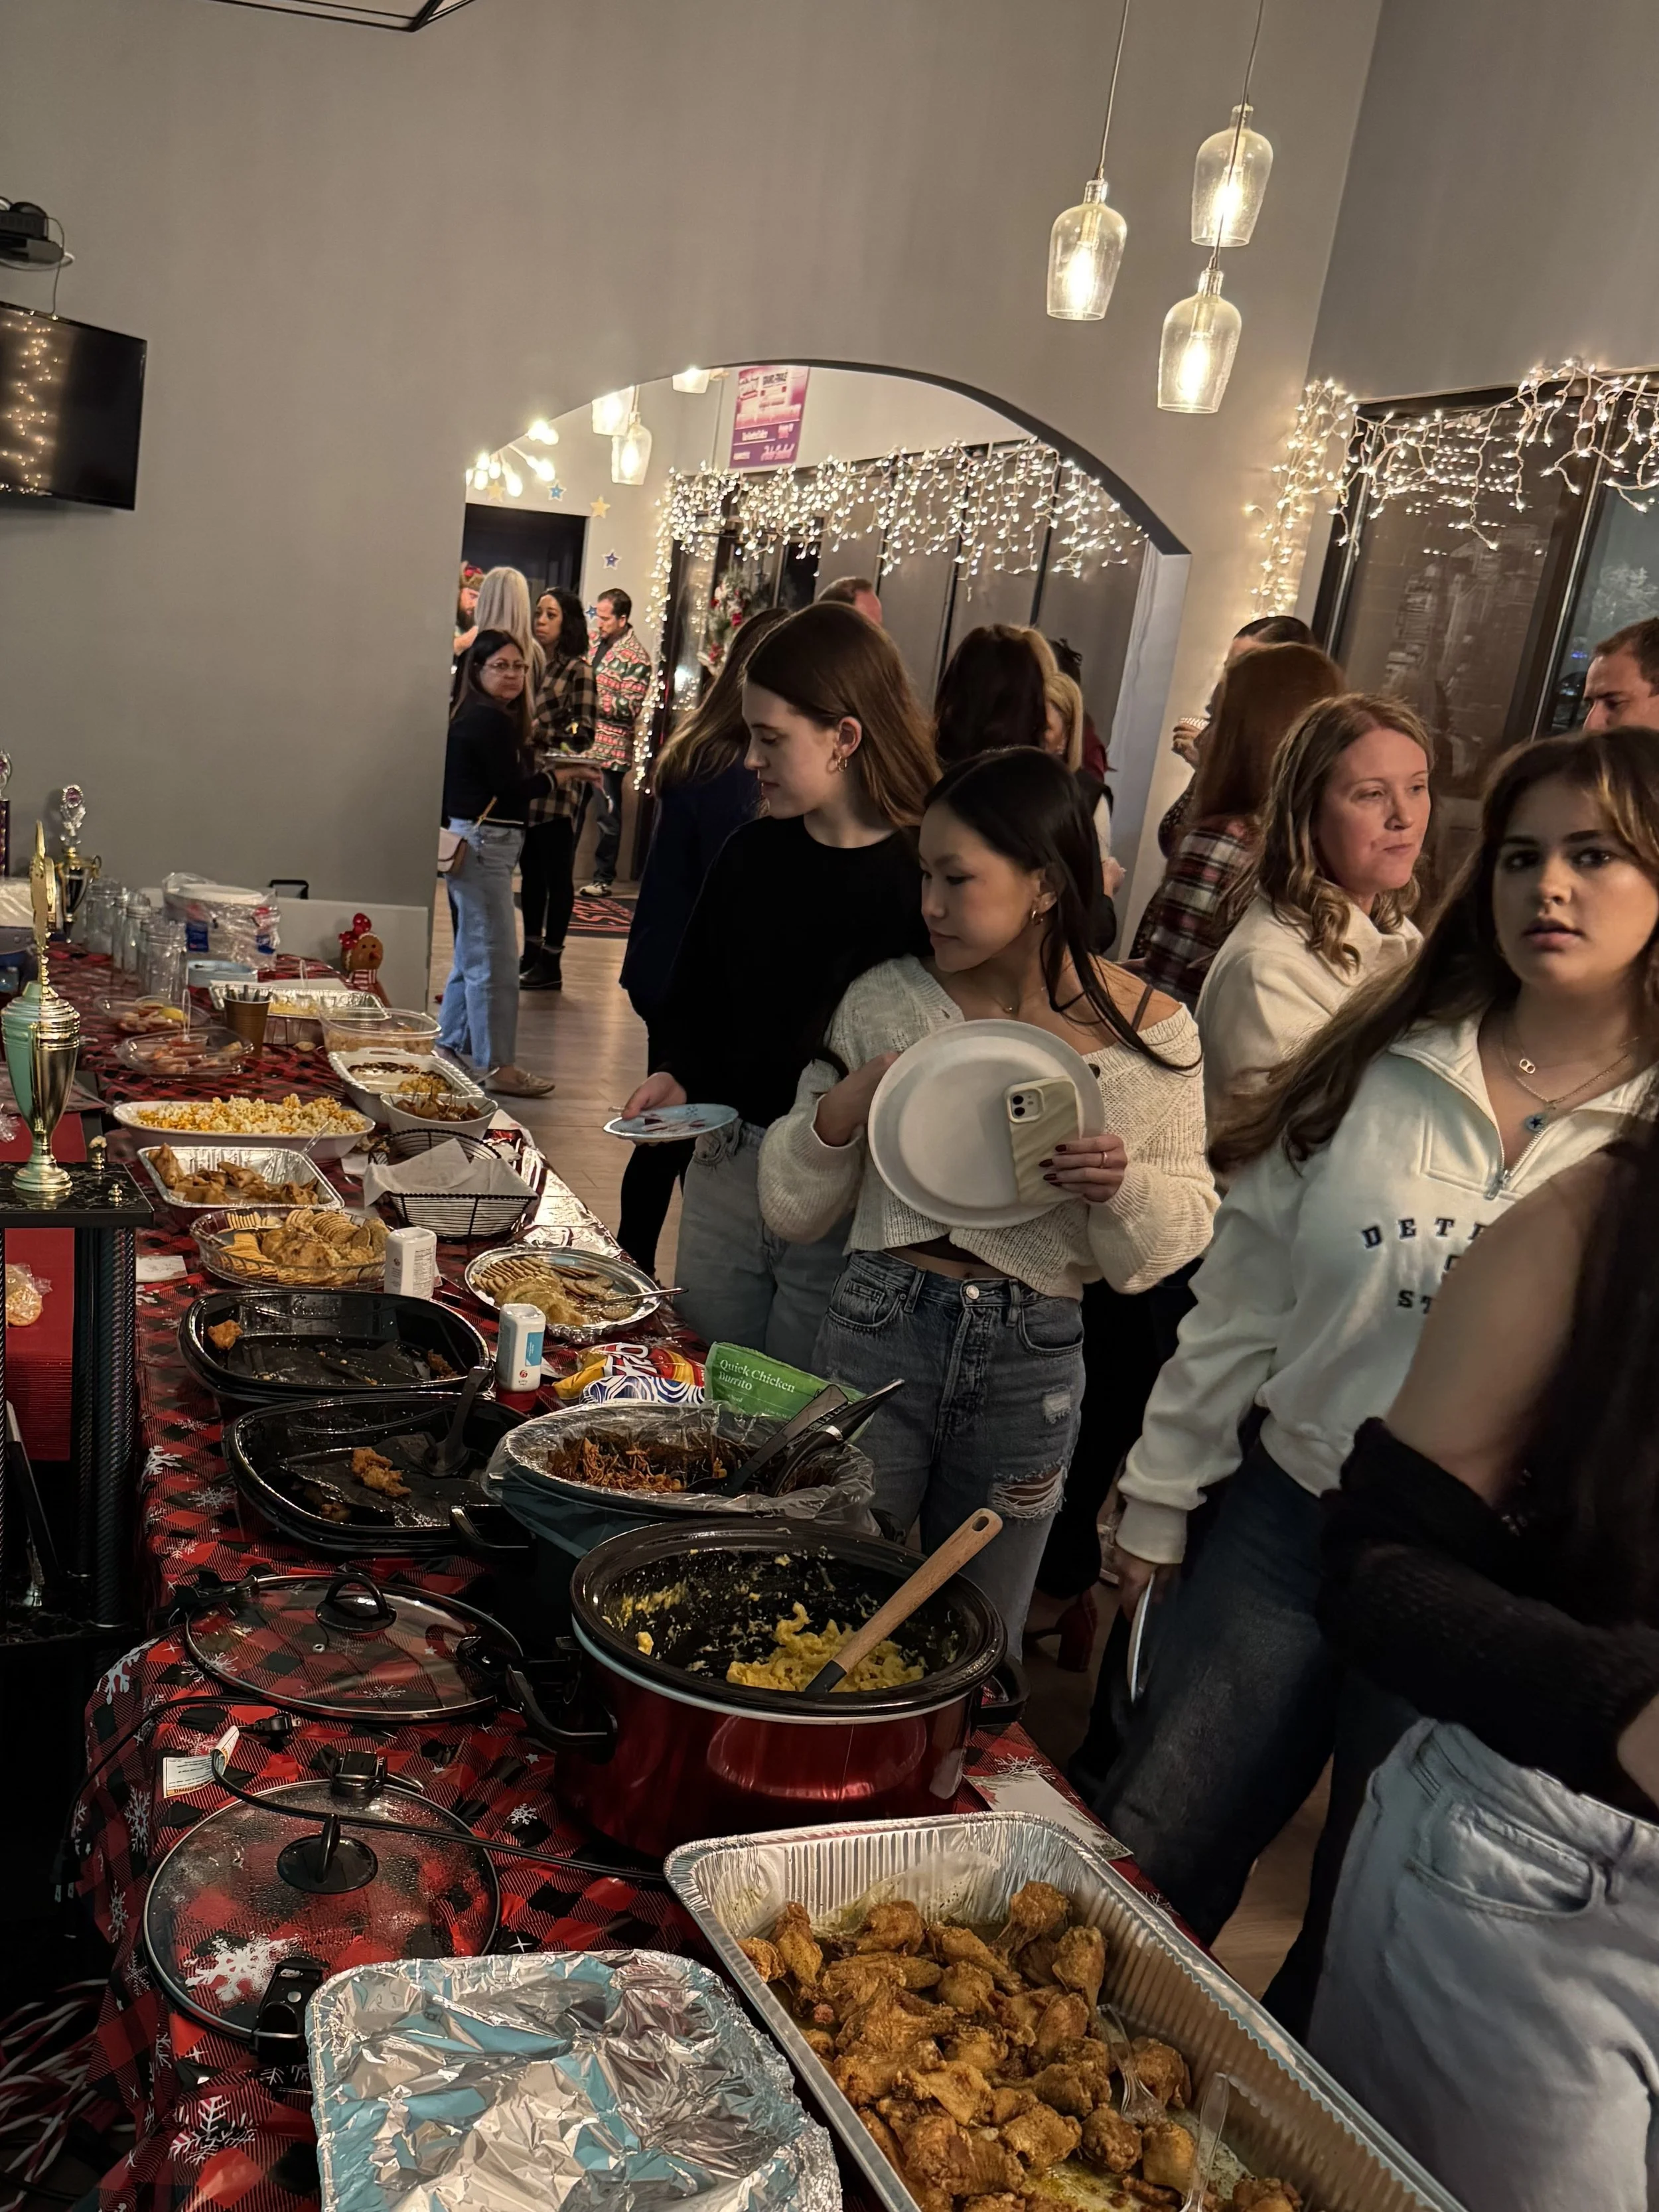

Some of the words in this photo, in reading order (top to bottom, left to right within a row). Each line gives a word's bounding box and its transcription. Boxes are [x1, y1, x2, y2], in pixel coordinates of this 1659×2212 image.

[719, 1359, 750, 1377] Quick
[751, 1370, 795, 1393] Chicken
[719, 1371, 753, 1390] Burrito
